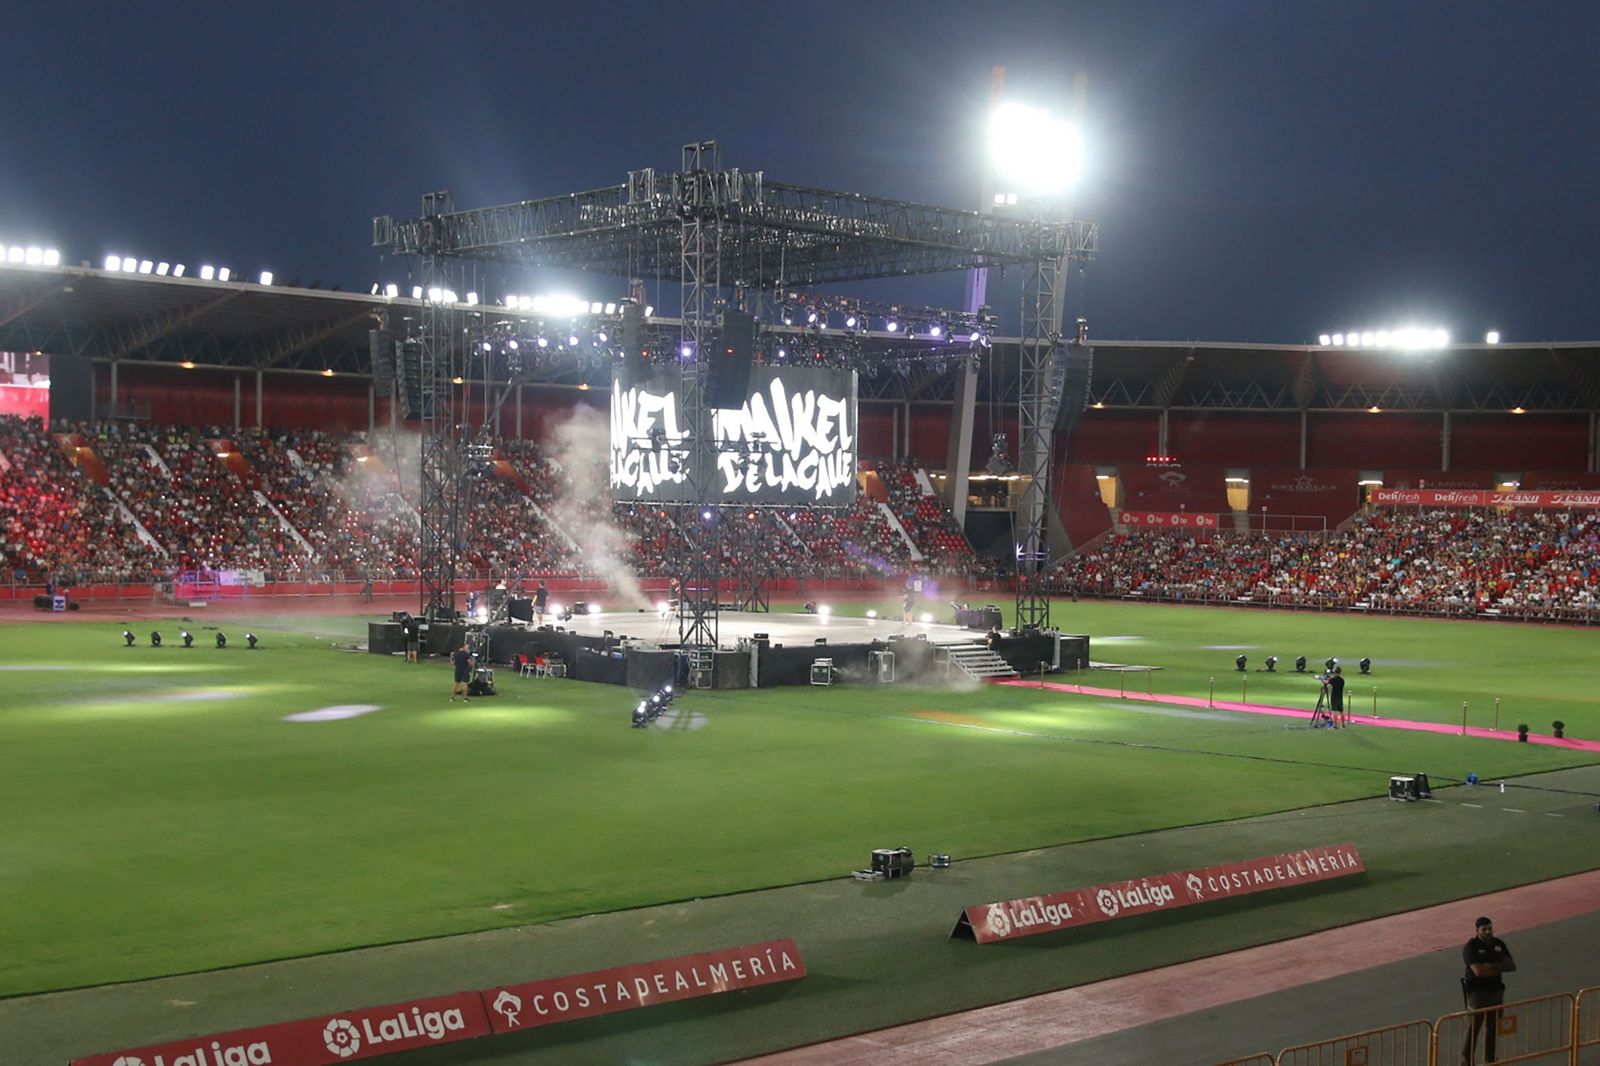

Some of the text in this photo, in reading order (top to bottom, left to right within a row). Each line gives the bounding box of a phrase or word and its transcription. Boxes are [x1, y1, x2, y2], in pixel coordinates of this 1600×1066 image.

[1008, 900, 1073, 929] LaLiga
[1117, 881, 1175, 909] LaLiga
[362, 1006, 465, 1044] LaLiga
